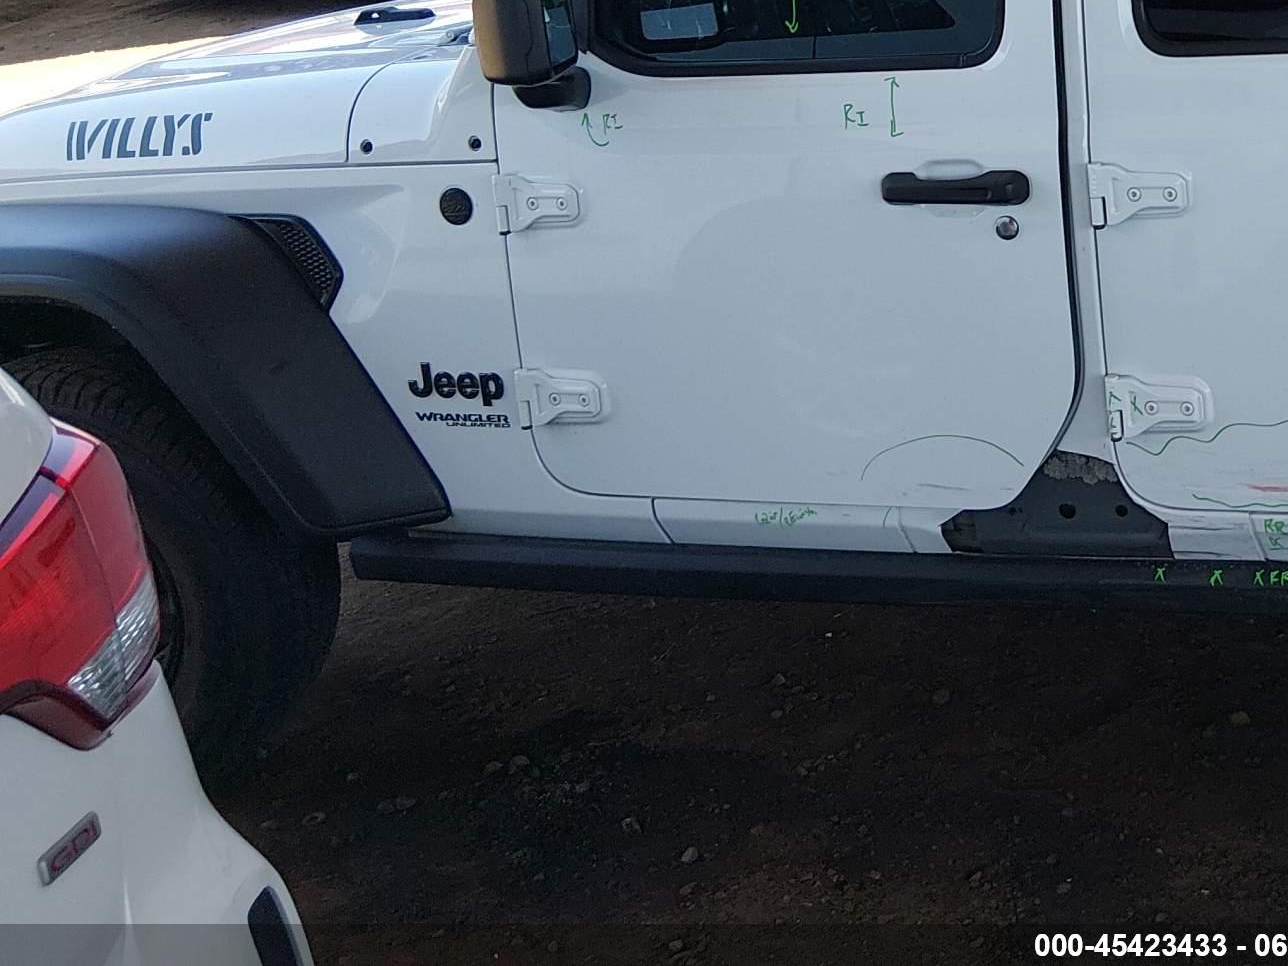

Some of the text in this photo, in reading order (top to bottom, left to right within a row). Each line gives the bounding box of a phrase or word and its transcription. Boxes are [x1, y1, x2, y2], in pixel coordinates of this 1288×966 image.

[843, 103, 870, 130] RI
[66, 112, 214, 162] WILLYS
[407, 361, 505, 407] Jeep
[415, 411, 510, 424] WRANGLER
